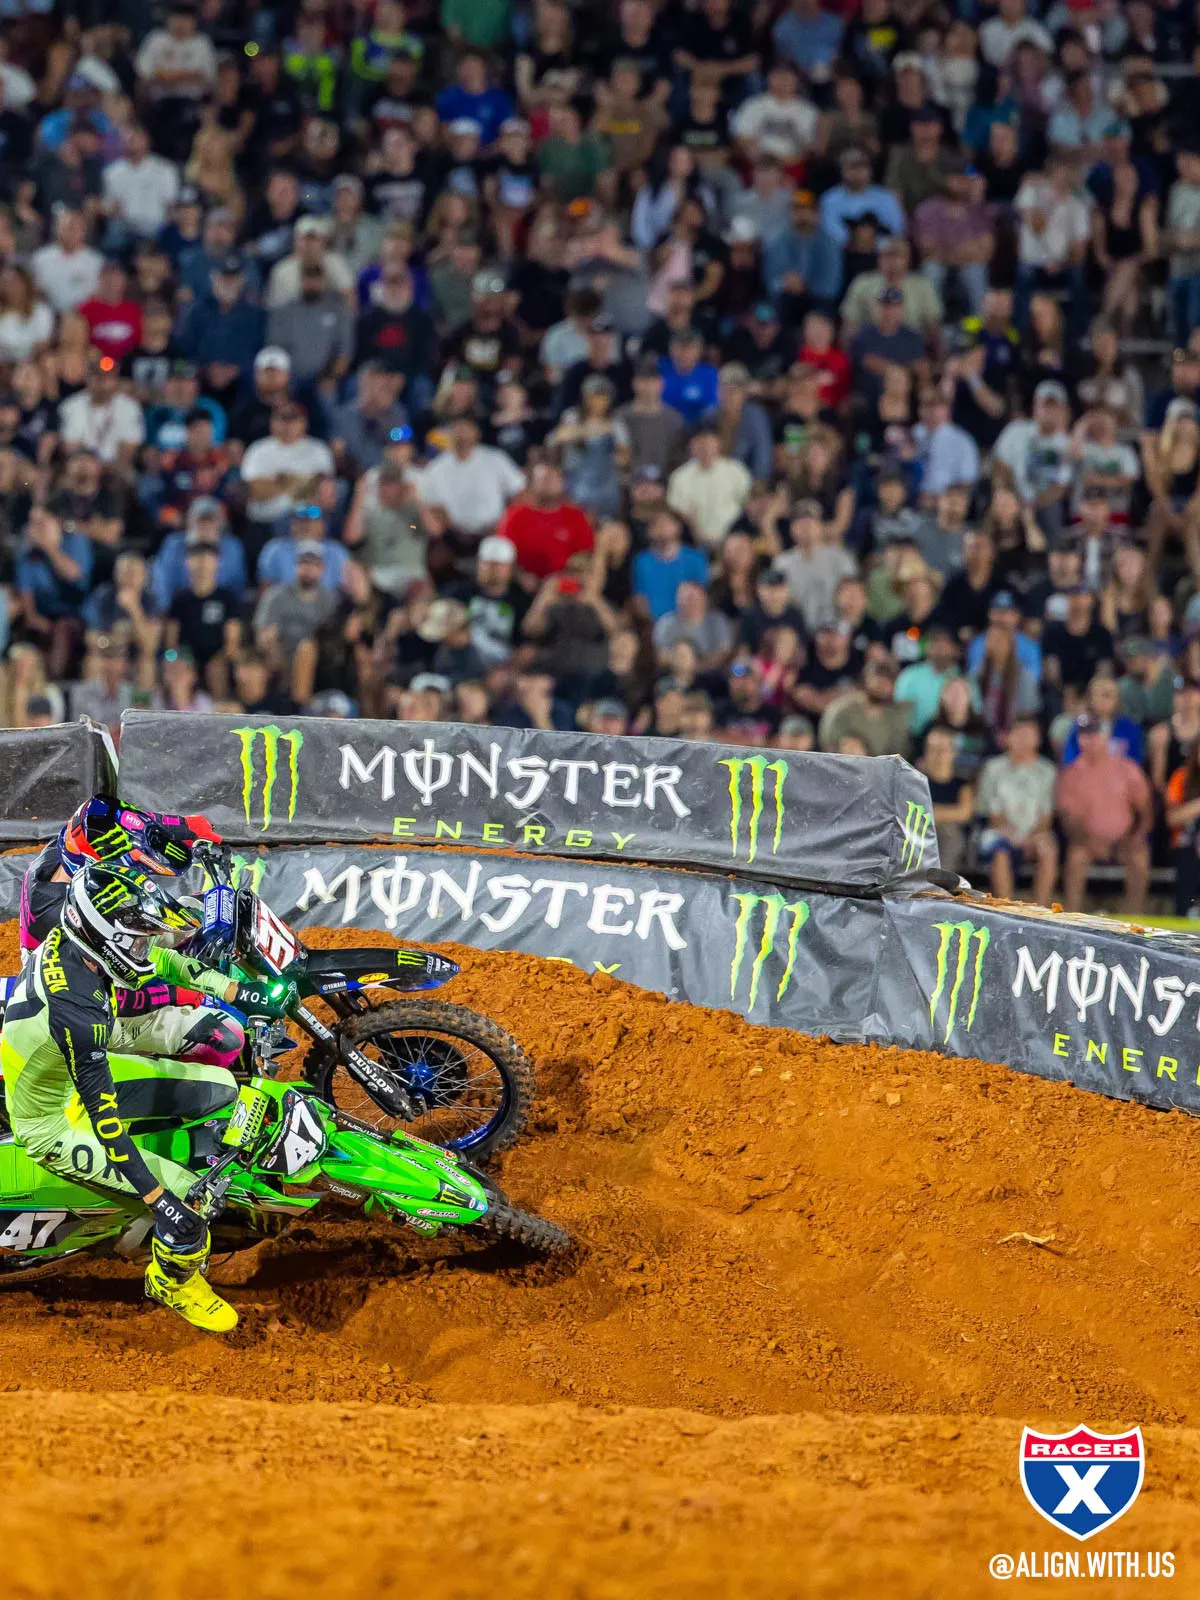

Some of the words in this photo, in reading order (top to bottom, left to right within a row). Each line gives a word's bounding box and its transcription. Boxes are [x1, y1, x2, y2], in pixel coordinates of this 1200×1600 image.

[339, 738, 692, 818] MONSTER
[392, 816, 637, 851] ENERGY
[296, 854, 688, 952] MONSTER
[101, 945, 129, 973] MONSTER
[239, 988, 269, 1006] FOX
[348, 1050, 394, 1094] DUNLOP
[1052, 1032, 1200, 1087] ENER
[240, 1096, 262, 1145] RENTHAL
[284, 1096, 323, 1176] 47
[157, 1199, 184, 1225] FOX
[331, 1185, 362, 1201] CIRCUIT
